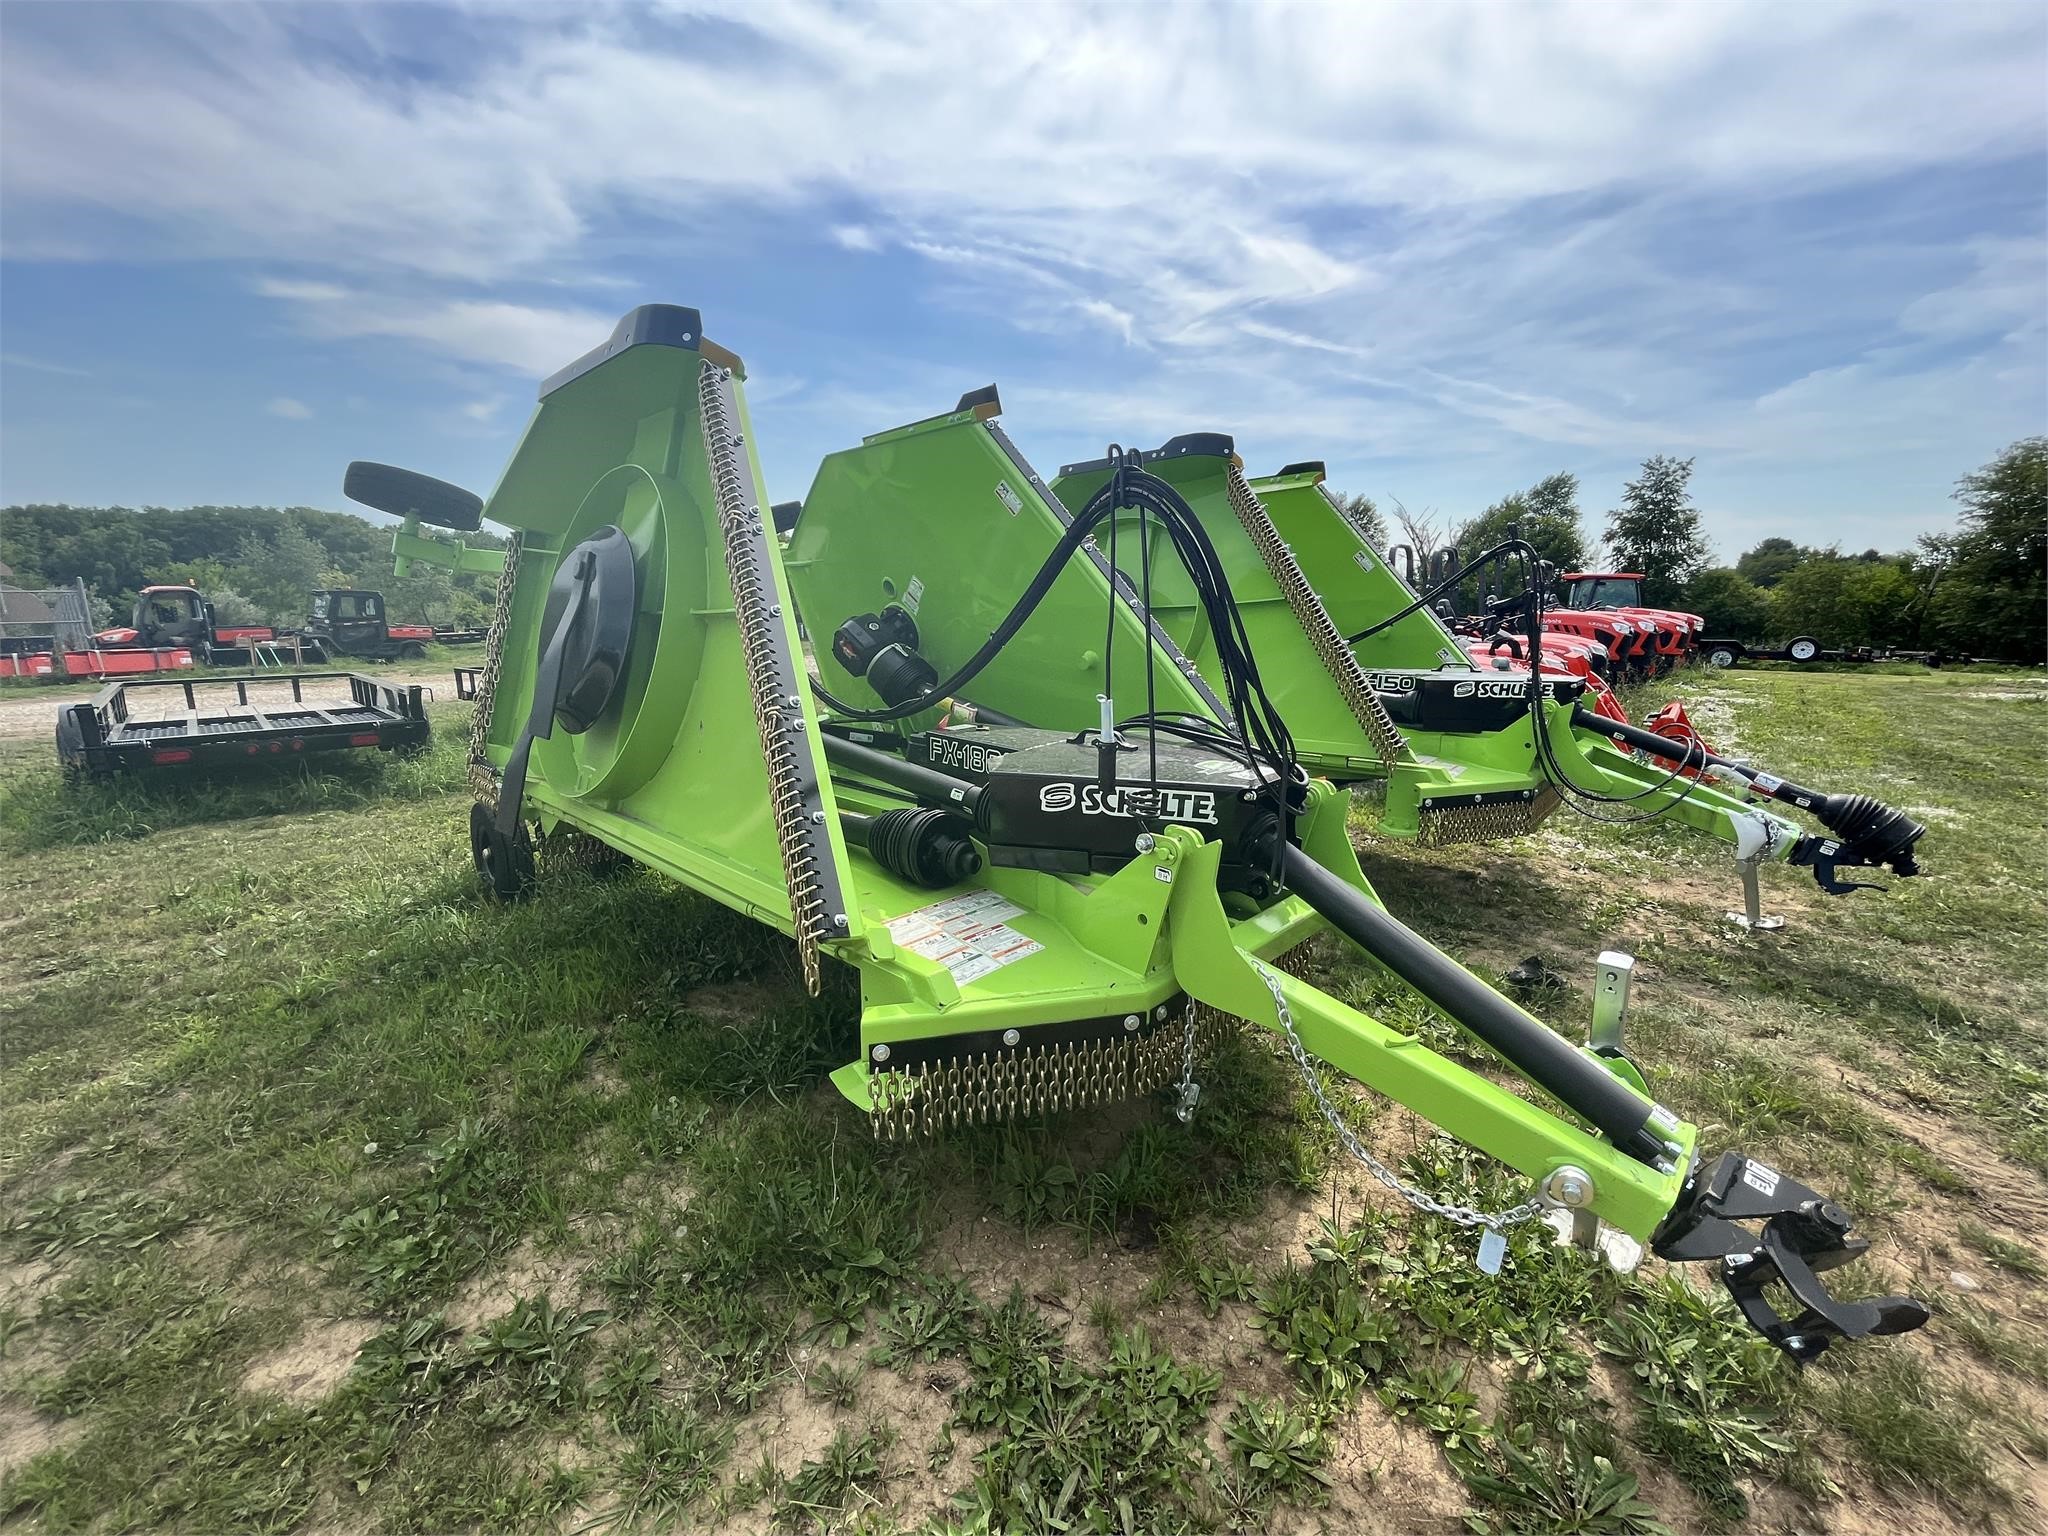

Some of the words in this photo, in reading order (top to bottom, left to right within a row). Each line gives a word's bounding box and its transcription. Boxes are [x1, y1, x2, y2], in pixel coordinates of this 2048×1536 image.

[1364, 674, 1416, 691] -150
[1478, 681, 1555, 699] SCHUE
[1081, 784, 1217, 824] SCHLTE
